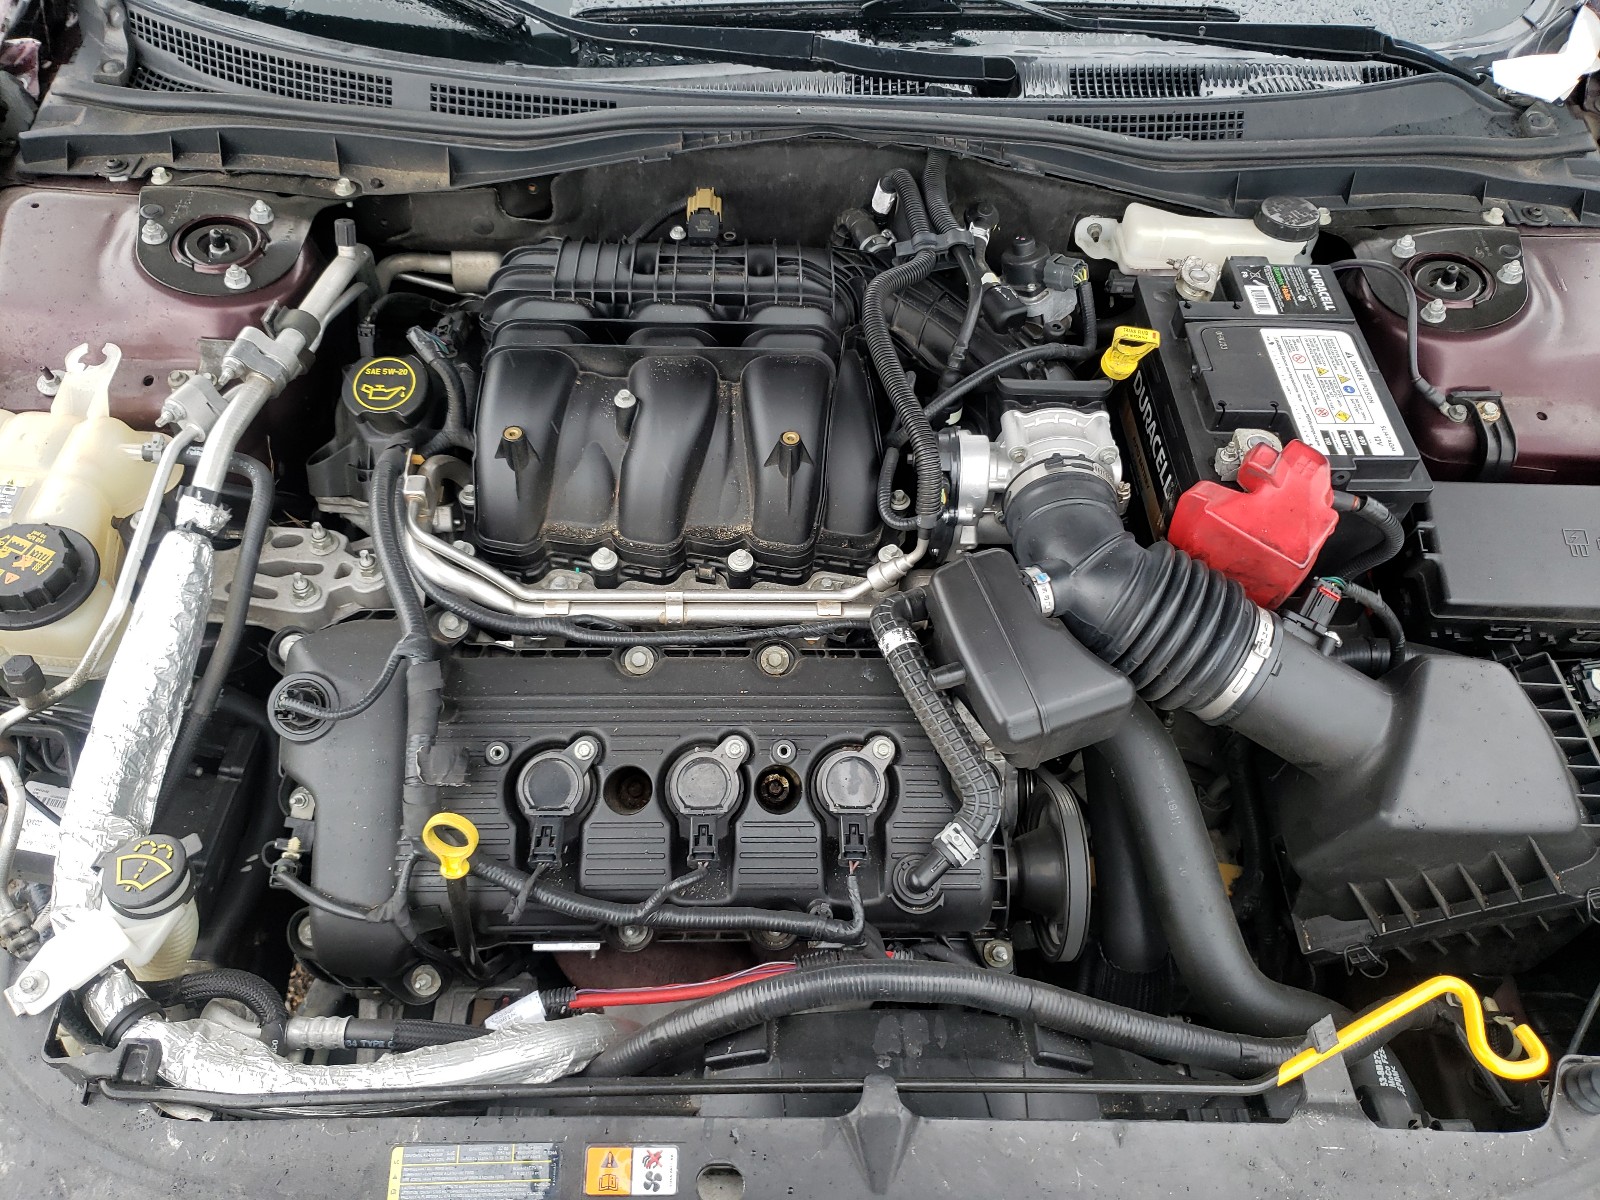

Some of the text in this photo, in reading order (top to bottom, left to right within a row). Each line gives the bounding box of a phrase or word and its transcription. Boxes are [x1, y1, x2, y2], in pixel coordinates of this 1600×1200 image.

[1307, 268, 1337, 311] DURACELL
[382, 368, 408, 376] 5W-20
[1133, 369, 1172, 501] DURACELL
[362, 1040, 386, 1049] TYPE
